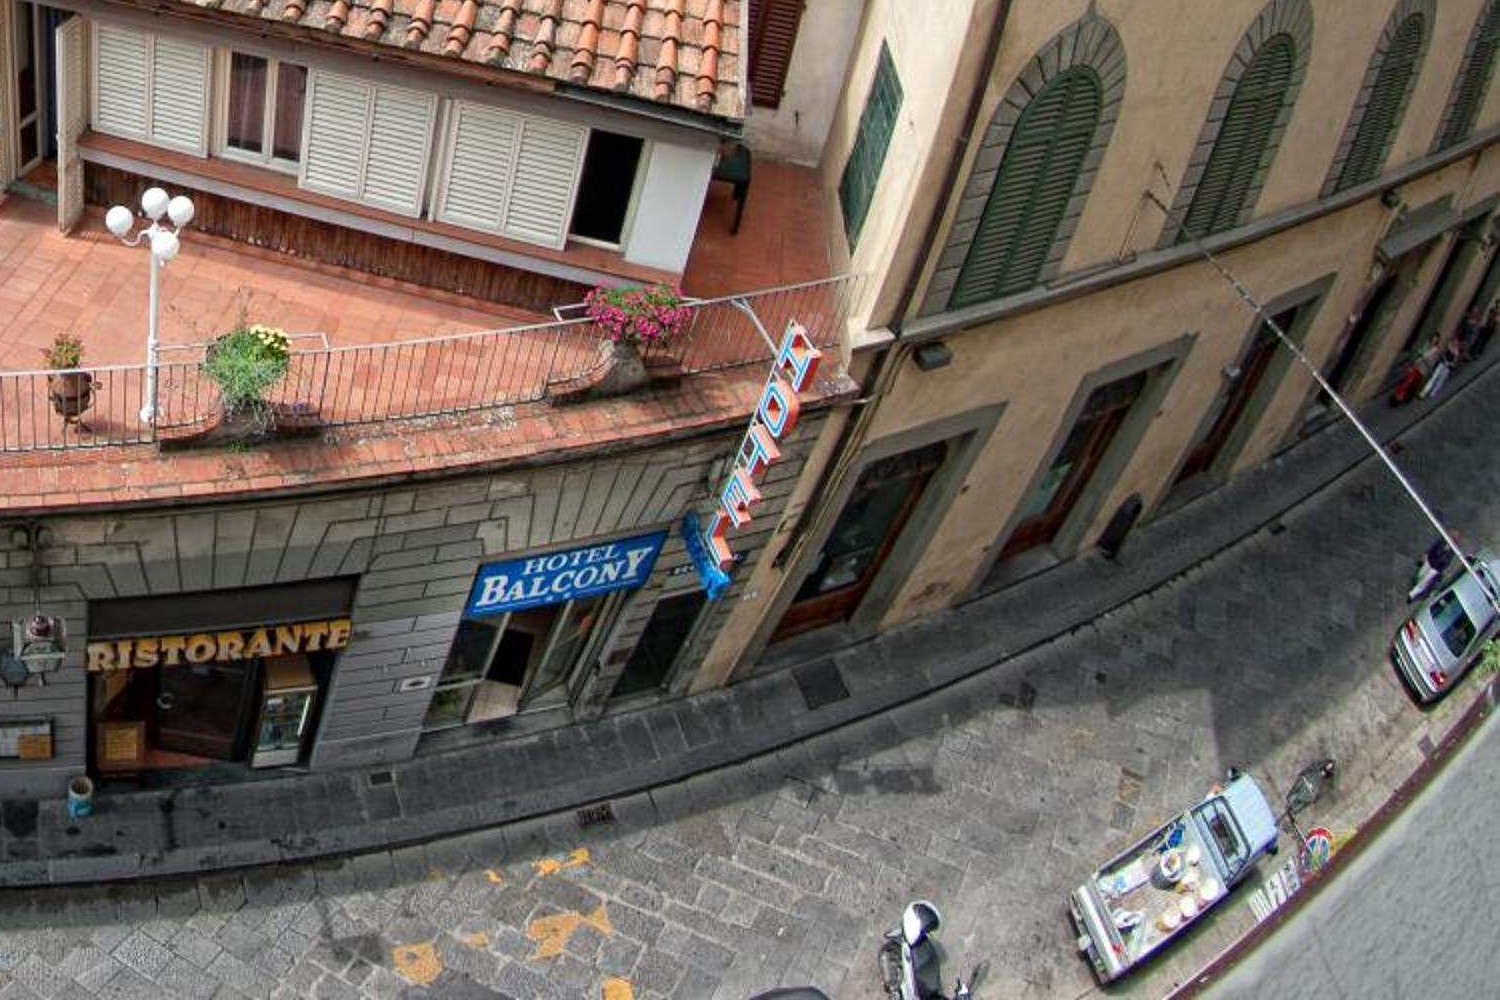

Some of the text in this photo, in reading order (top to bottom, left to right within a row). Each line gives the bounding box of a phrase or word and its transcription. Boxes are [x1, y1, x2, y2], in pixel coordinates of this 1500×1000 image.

[706, 319, 821, 570] HOTEL
[475, 547, 653, 606] BALCONY
[524, 544, 618, 575] HOTEL
[86, 618, 350, 672] RISTORANTE
